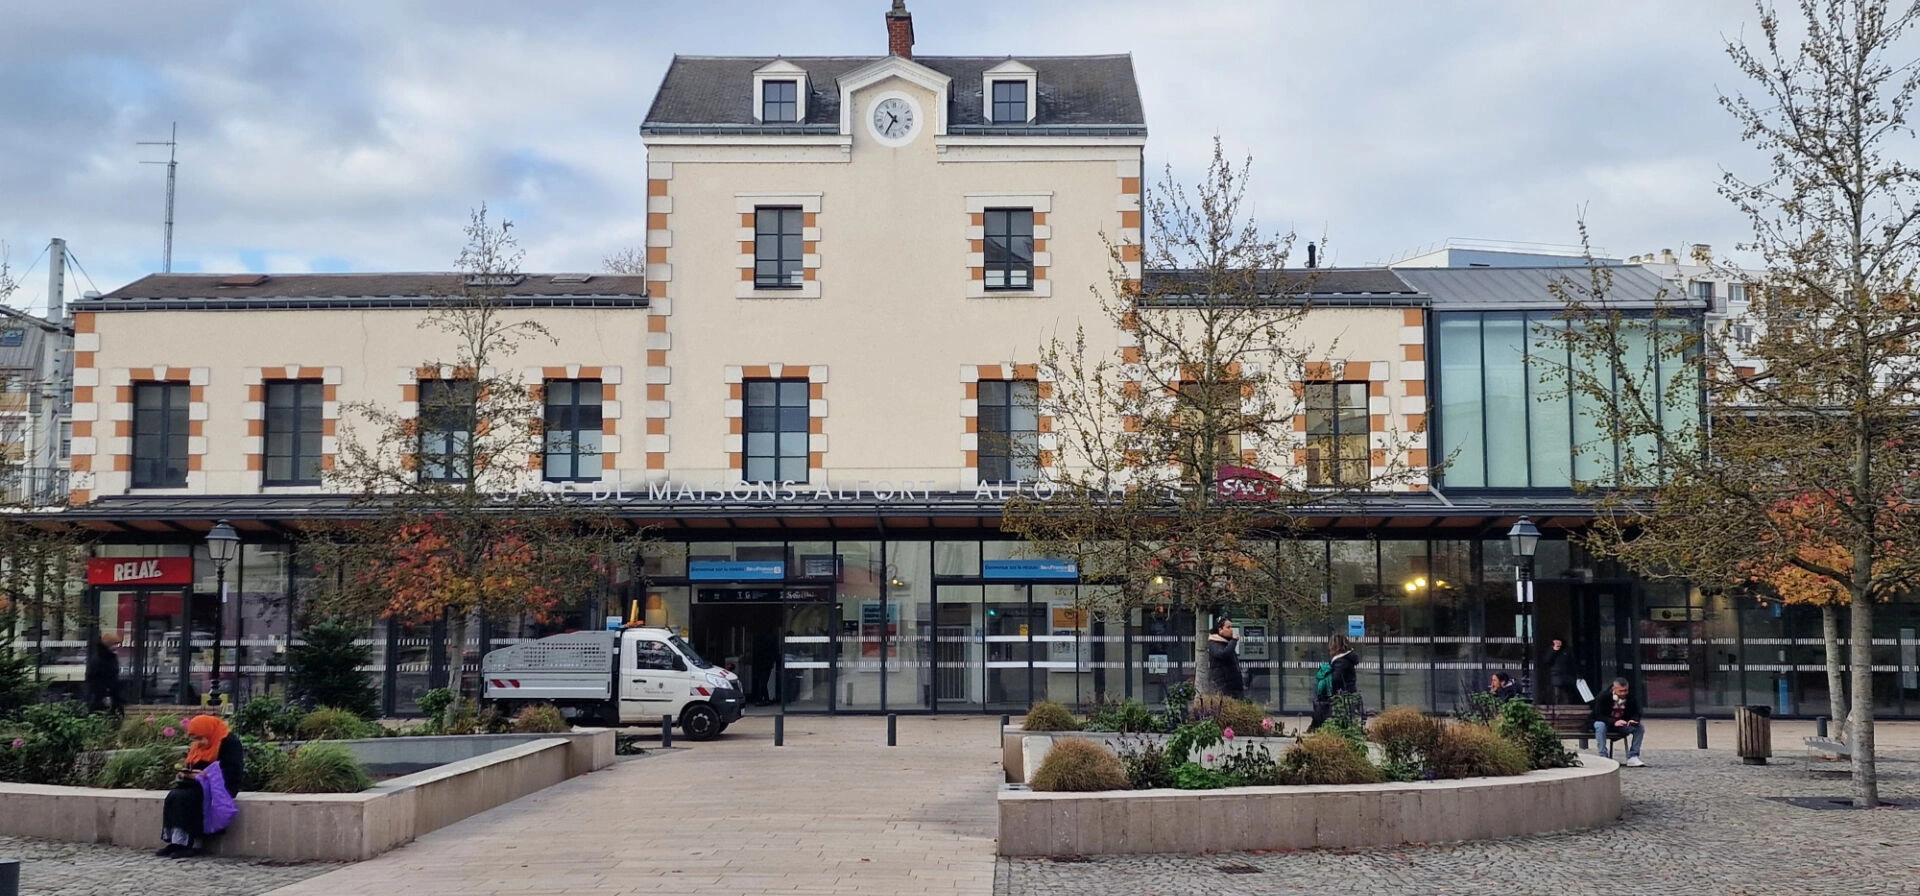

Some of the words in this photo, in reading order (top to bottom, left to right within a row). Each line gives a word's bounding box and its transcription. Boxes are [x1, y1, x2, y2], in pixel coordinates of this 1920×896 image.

[592, 481, 632, 501] DE
[649, 480, 936, 501] MAISONS-ALFORT
[1219, 479, 1276, 496] SNC
[113, 560, 160, 582] RELAY
